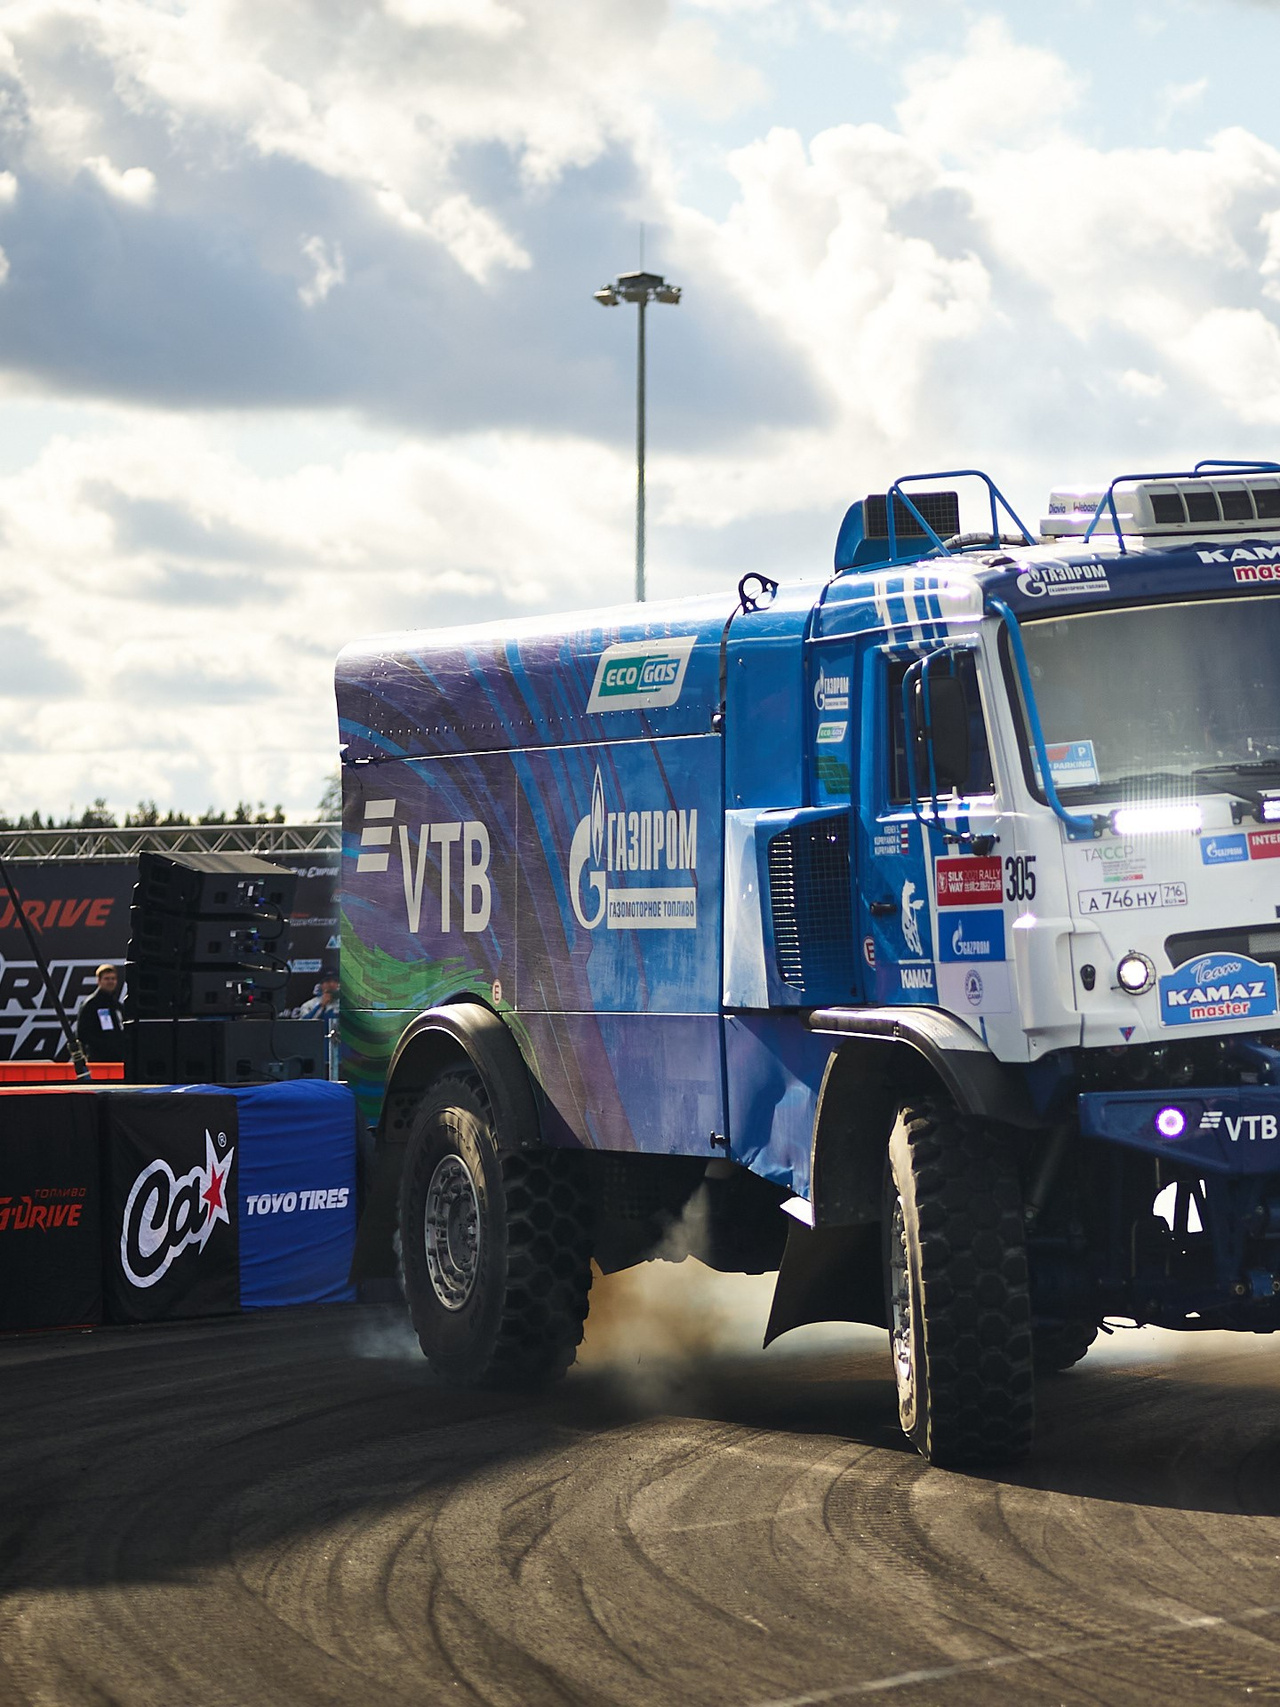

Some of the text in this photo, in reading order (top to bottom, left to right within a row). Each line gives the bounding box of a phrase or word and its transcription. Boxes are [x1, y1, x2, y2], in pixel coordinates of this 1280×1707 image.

[1042, 564, 1106, 583] ГАЗПРОМ
[824, 677, 849, 694] ГАЗПРОМ
[1053, 761, 1091, 769] PARKING
[608, 809, 698, 871] ГАЗПРОМ
[399, 821, 491, 933] VTB
[948, 871, 963, 881] SILK
[979, 869, 1001, 879] RALLY
[1005, 856, 1036, 901] 305
[948, 882, 963, 892] WAY
[1164, 886, 1182, 897] 716
[609, 901, 694, 917] ГАЗОМОТОРНОЕ ТОПЛИВО
[962, 941, 990, 954] GAZPROM
[901, 968, 933, 988] KAMAZ
[1190, 959, 1242, 985] Team
[1167, 982, 1266, 1006] KAMAZ
[1190, 1002, 1250, 1019] master
[1225, 1115, 1278, 1141] VTB
[246, 1188, 349, 1215] TOYO TIRES
